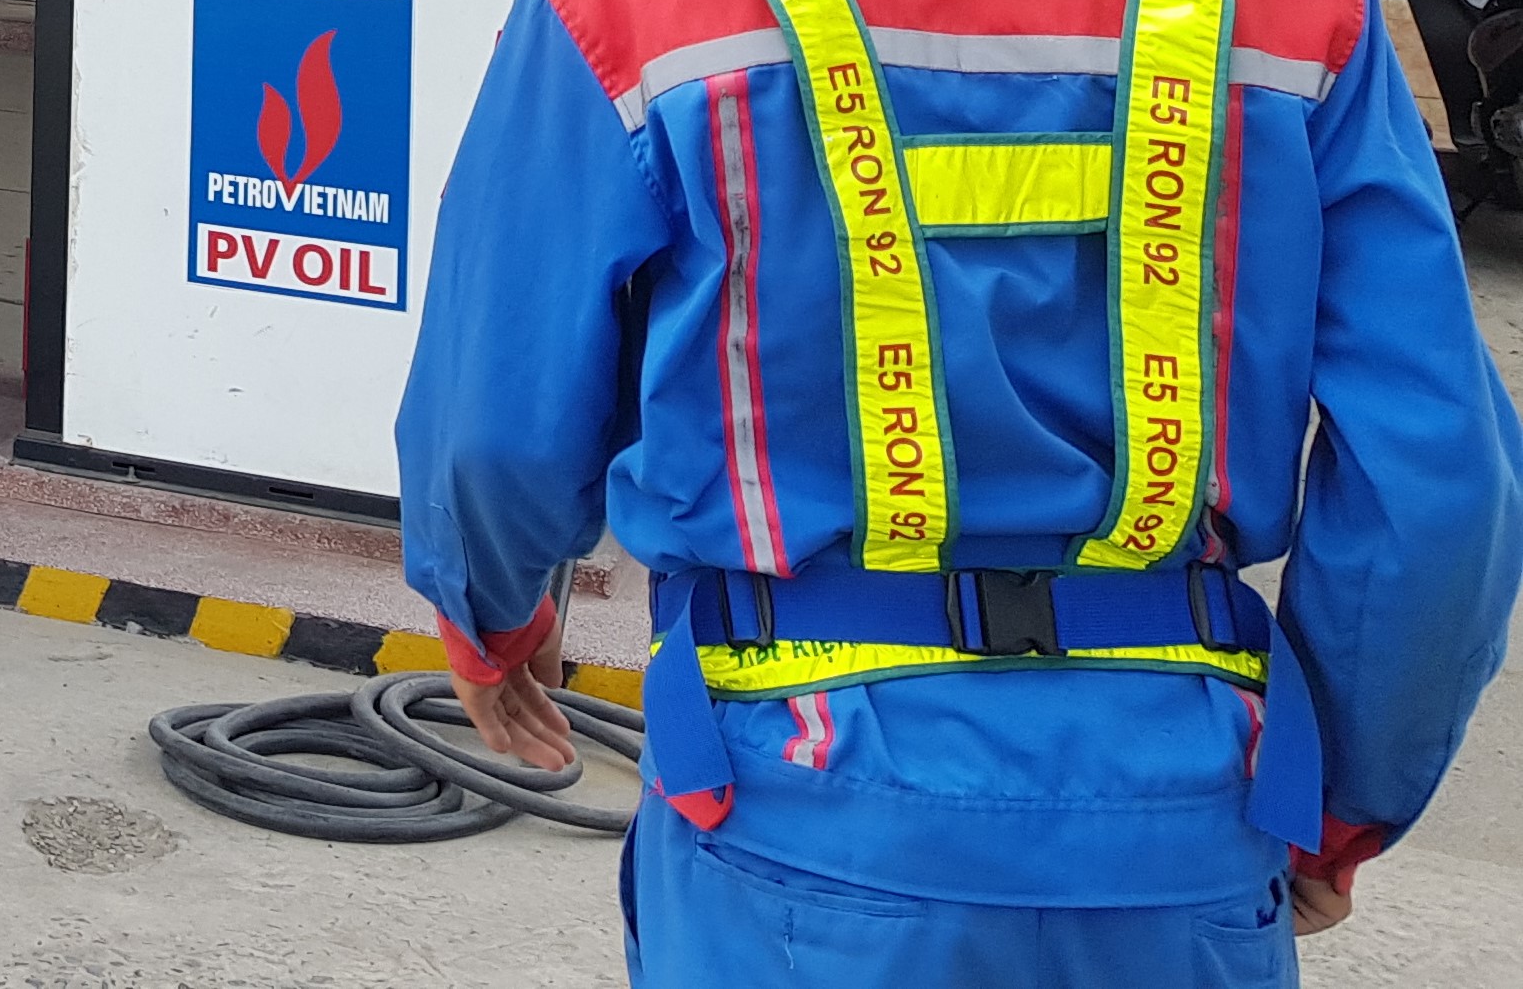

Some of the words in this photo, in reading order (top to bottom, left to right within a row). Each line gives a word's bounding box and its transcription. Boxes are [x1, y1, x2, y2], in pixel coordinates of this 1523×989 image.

[827, 62, 867, 114] E5
[1149, 75, 1191, 126] E5
[842, 125, 891, 217] RON
[1144, 139, 1186, 231] RON
[208, 172, 389, 223] PETROVIETNAM
[293, 244, 386, 295] OIL
[866, 231, 902, 277] 92
[1143, 243, 1180, 286] 92
[878, 343, 913, 391] E5
[1143, 353, 1178, 403] E5
[882, 407, 926, 497] RON
[1142, 417, 1181, 507] RON
[888, 512, 926, 541] 92
[1122, 514, 1164, 551] 92
